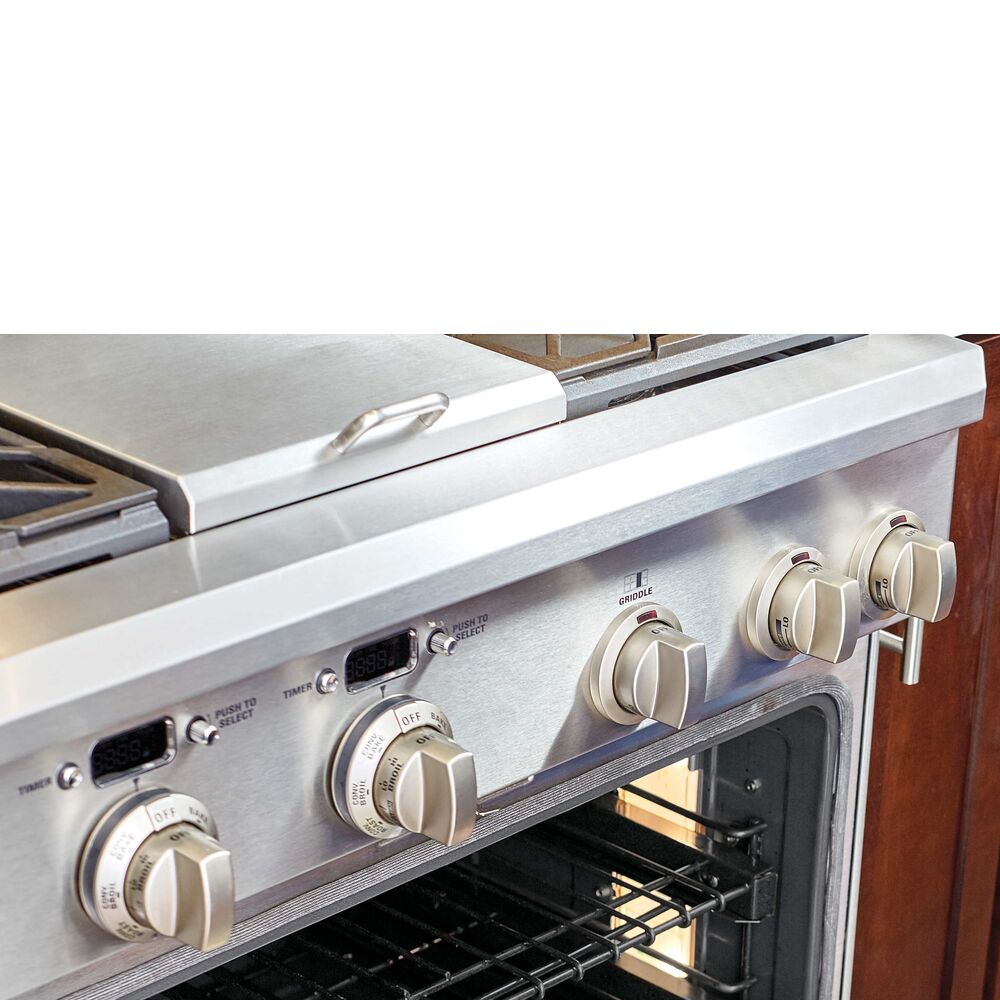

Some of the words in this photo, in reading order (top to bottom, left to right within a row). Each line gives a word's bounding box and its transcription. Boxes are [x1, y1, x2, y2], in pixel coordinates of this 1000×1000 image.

[882, 578, 889, 589] LO
[619, 586, 653, 606] GRIDDLE
[452, 616, 476, 634] PUSH
[476, 613, 489, 625] TO
[782, 616, 789, 628] LO
[455, 624, 486, 641] SELECT
[283, 682, 313, 699] TIMER
[215, 702, 242, 720] PUSH
[243, 697, 257, 710] TO
[218, 709, 255, 728] SELECT
[401, 712, 422, 727] OFF
[361, 732, 379, 757] CONV
[367, 736, 387, 761] BAKE
[352, 783, 360, 806] CONV
[359, 778, 368, 806] BROIL
[153, 807, 177, 823] OFF
